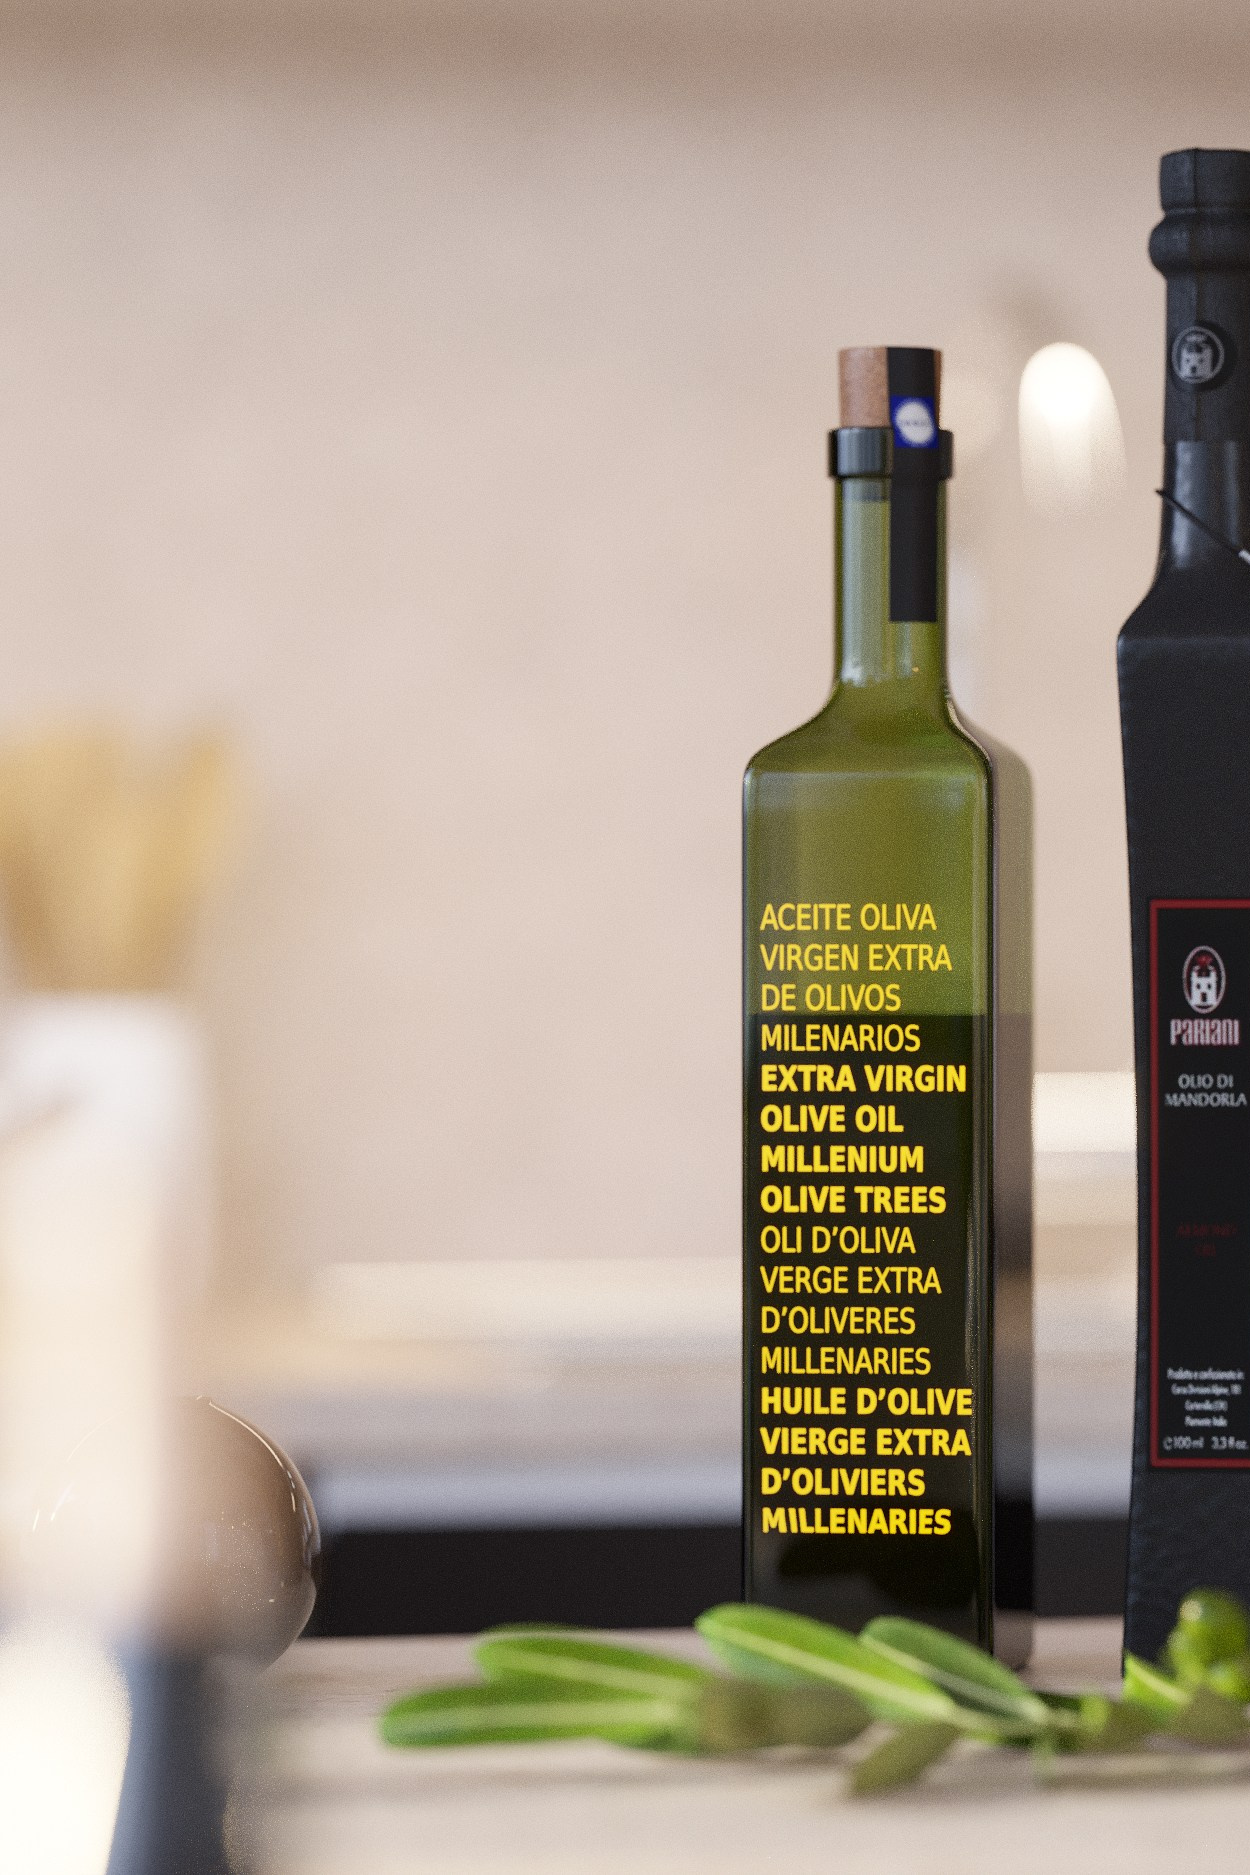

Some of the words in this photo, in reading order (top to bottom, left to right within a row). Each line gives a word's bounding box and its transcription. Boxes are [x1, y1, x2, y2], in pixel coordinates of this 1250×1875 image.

[760, 903, 851, 931] ACEITE
[860, 903, 937, 931] OLIVA
[760, 943, 858, 972] VIRGEN
[869, 943, 952, 971] EXTRA
[762, 984, 796, 1011] DE
[804, 983, 901, 1011] OLIVOS
[762, 1024, 920, 1052] MILENARIOS
[762, 1065, 856, 1091] EXTRA
[864, 1065, 966, 1092] VIRGIN
[1178, 1074, 1213, 1089] OLIO
[1217, 1074, 1233, 1088] DI
[1166, 1093, 1247, 1107] MANDORLA
[761, 1105, 845, 1132] OLIVE
[855, 1105, 904, 1132] OIL
[762, 1145, 923, 1173] MILLENIUM
[761, 1185, 845, 1213] OLIVE
[854, 1186, 946, 1213] TREES
[761, 1226, 801, 1253] OLI
[812, 1226, 916, 1253] D'OLIVA
[760, 1266, 848, 1293] VERGE
[858, 1267, 941, 1294] EXTRA
[762, 1306, 915, 1334] D'OLIVERES
[762, 1347, 931, 1375] MILLENARIES
[762, 1387, 846, 1414] HUILE
[857, 1388, 972, 1415] D'OLIVE
[760, 1427, 866, 1455] VIERGE
[877, 1428, 971, 1456] EXTRA
[762, 1468, 925, 1496] D'OLIVIERS
[763, 1507, 951, 1535] MILLENARIES
